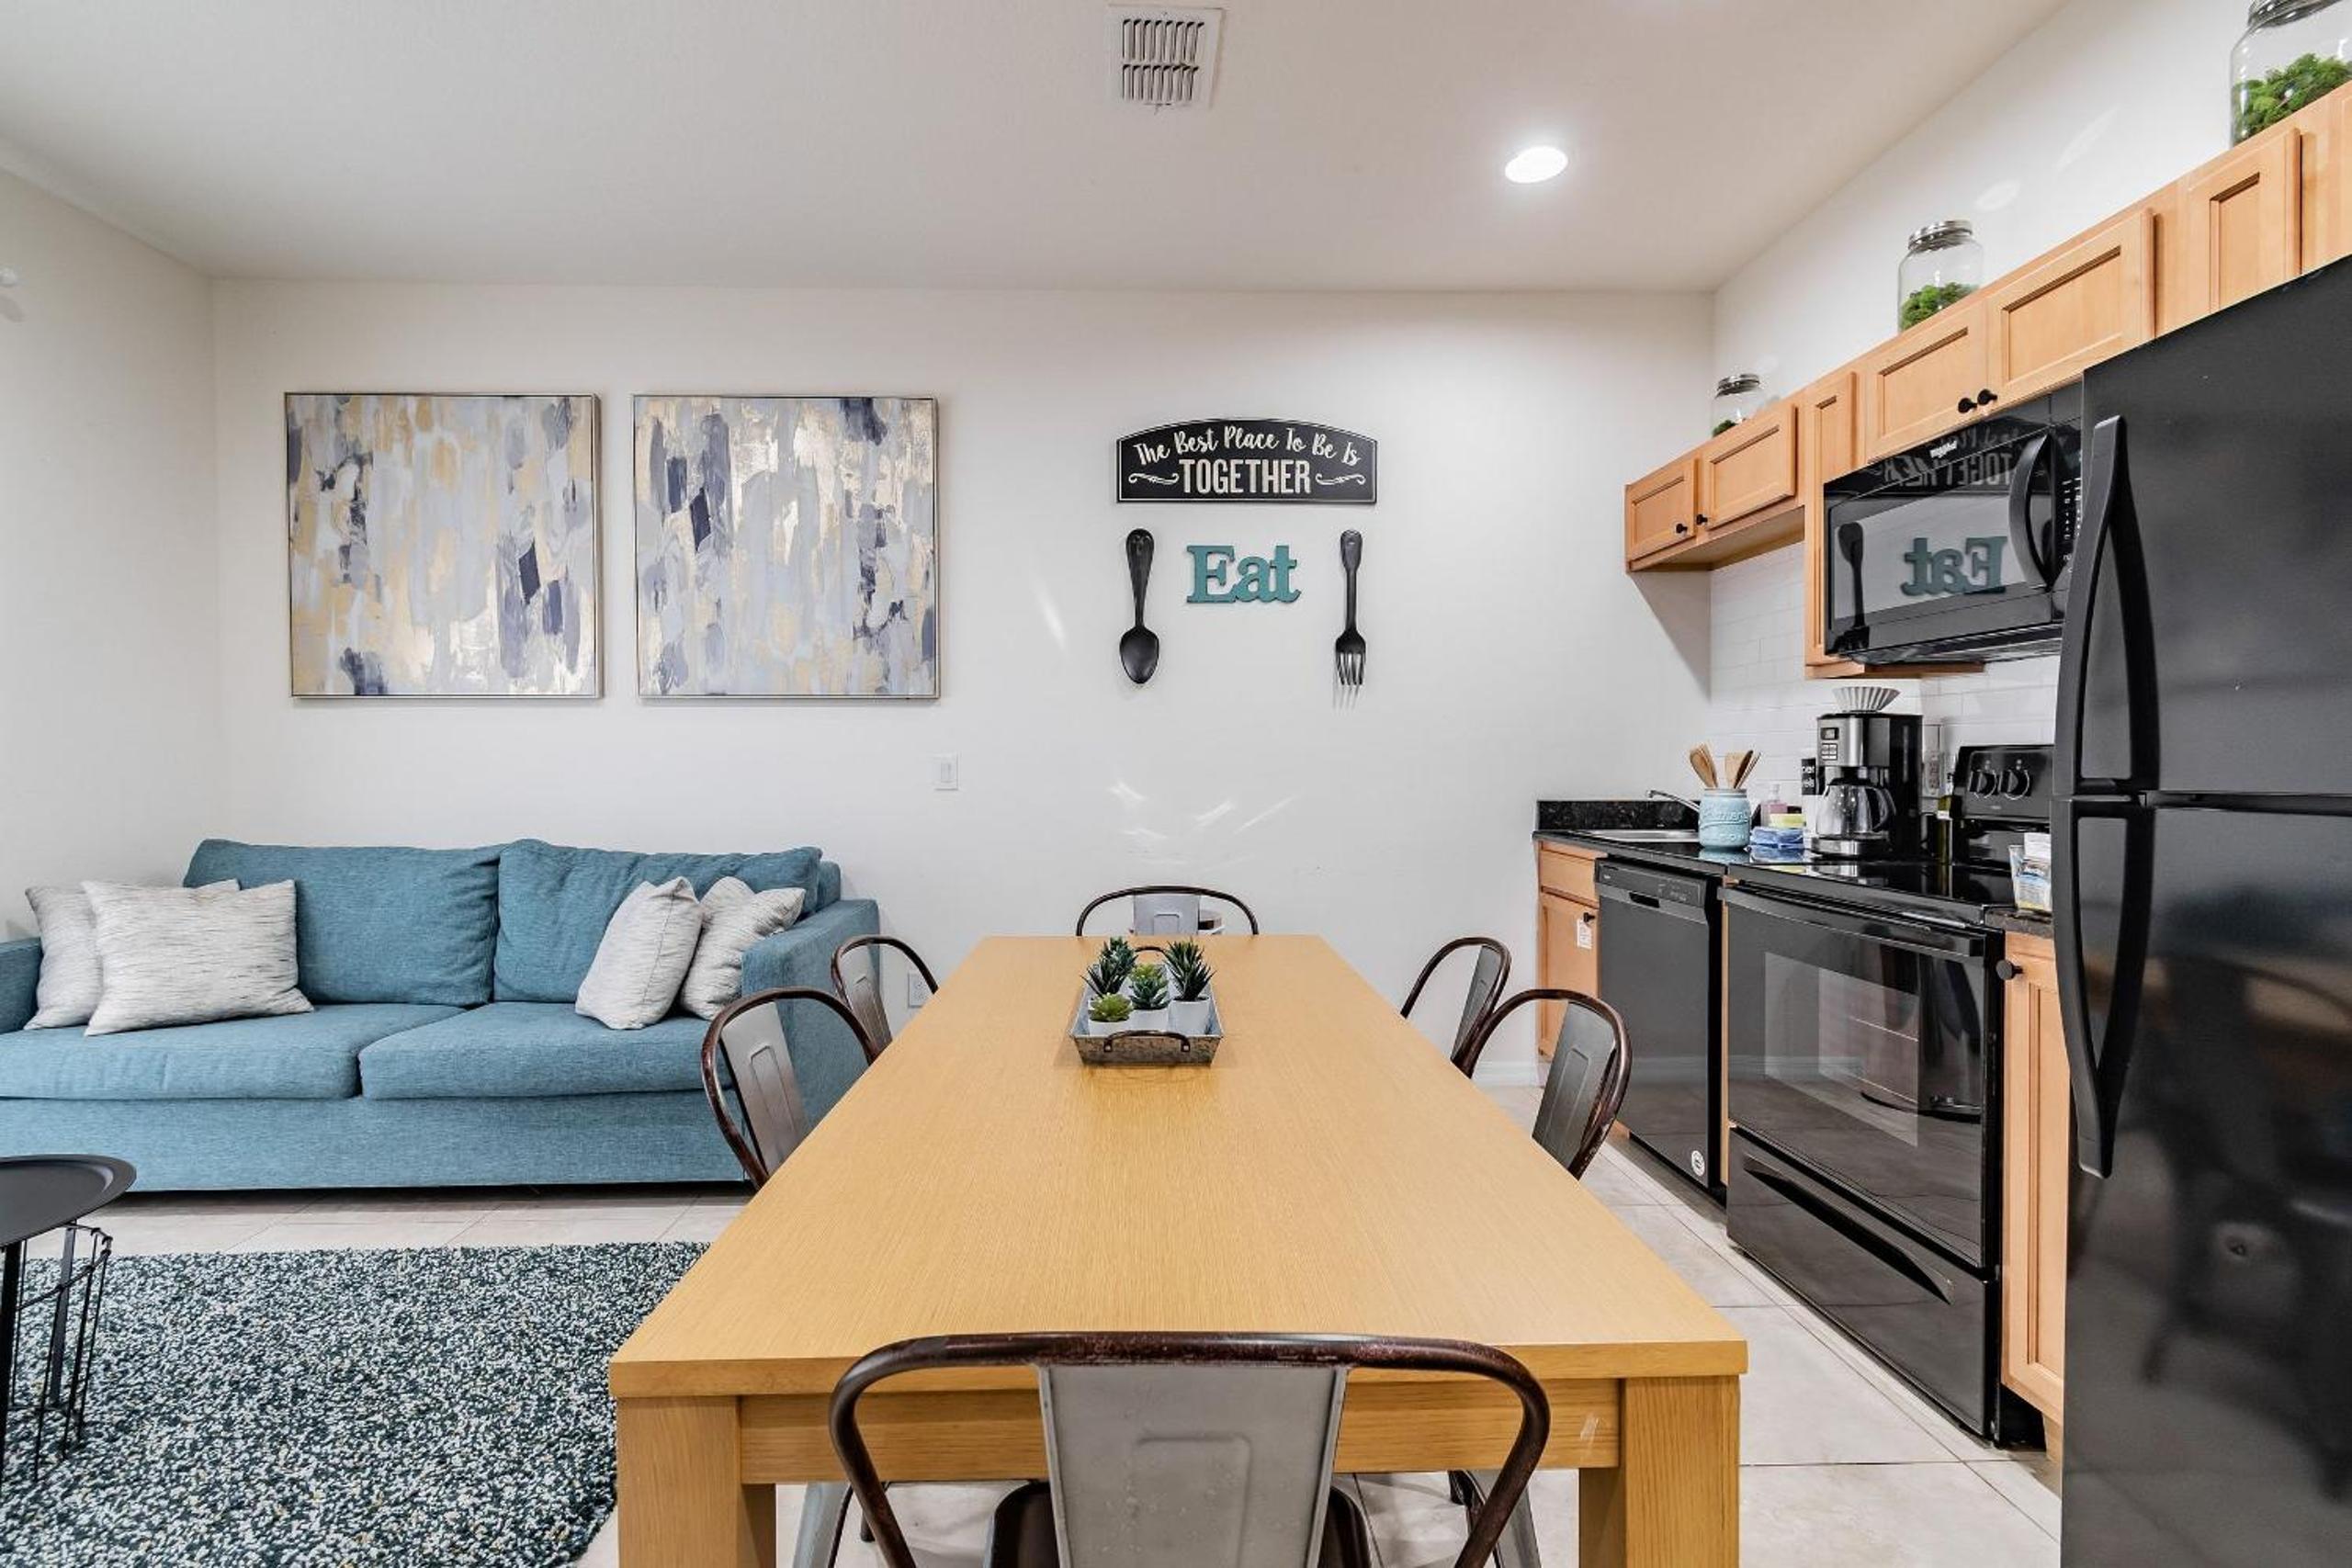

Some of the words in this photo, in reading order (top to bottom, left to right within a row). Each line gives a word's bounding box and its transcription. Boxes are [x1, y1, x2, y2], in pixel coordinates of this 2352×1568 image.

[1134, 443, 1170, 465] The
[1174, 428, 1218, 454] Best
[1224, 426, 1278, 449] Place
[1285, 427, 1306, 452] To
[1312, 434, 1337, 457] Be
[1341, 442, 1361, 466] Is
[1179, 459, 1311, 493] TOGETHER
[1187, 546, 1302, 604] Eat
